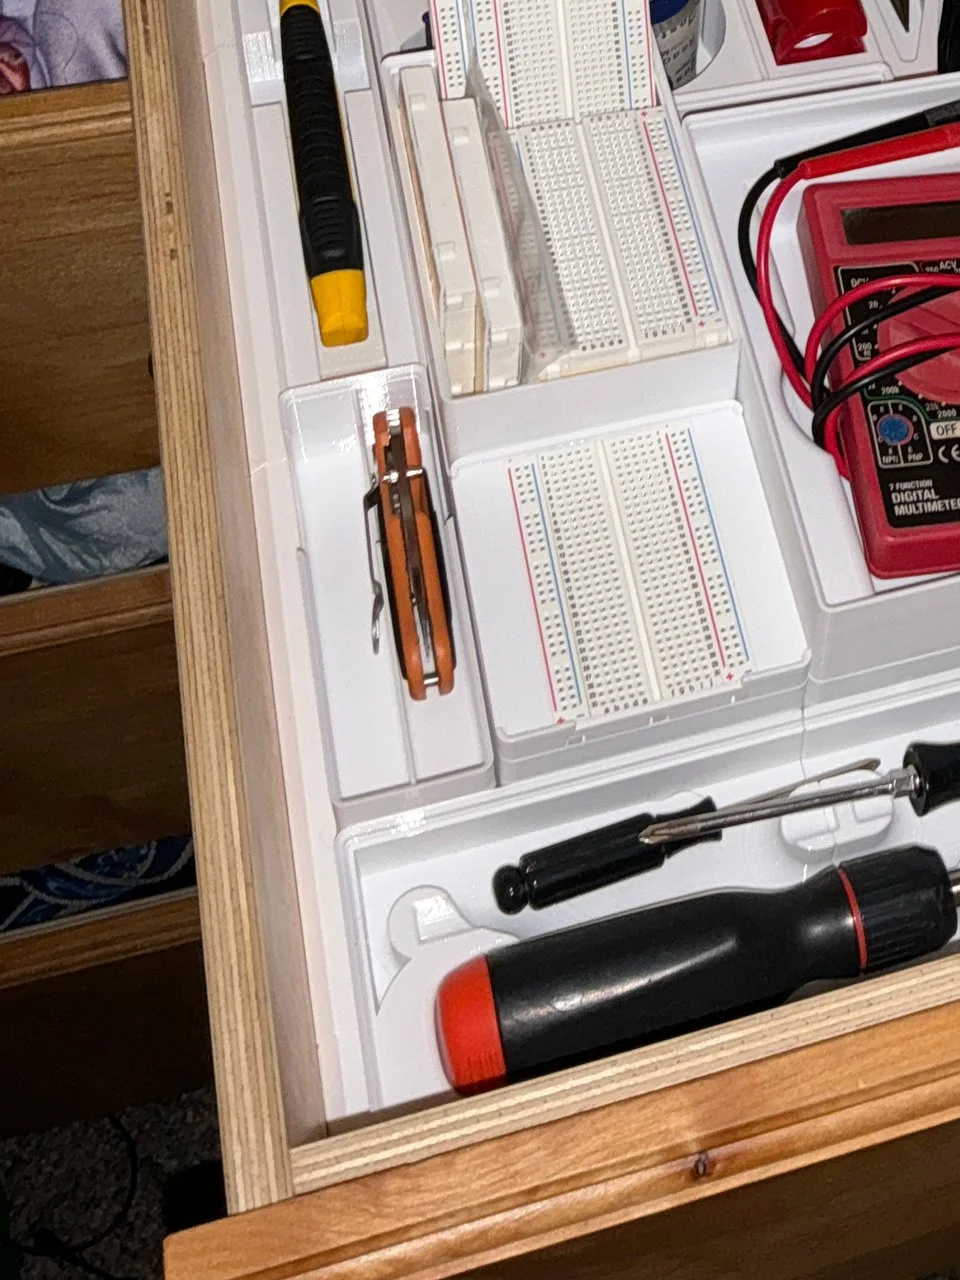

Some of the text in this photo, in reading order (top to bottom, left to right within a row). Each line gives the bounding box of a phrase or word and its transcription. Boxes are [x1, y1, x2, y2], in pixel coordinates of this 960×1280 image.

[868, 300, 879, 309] 20
[936, 422, 957, 436] OFF
[896, 478, 934, 491] FUNCTION
[891, 488, 940, 504] DIGITAL
